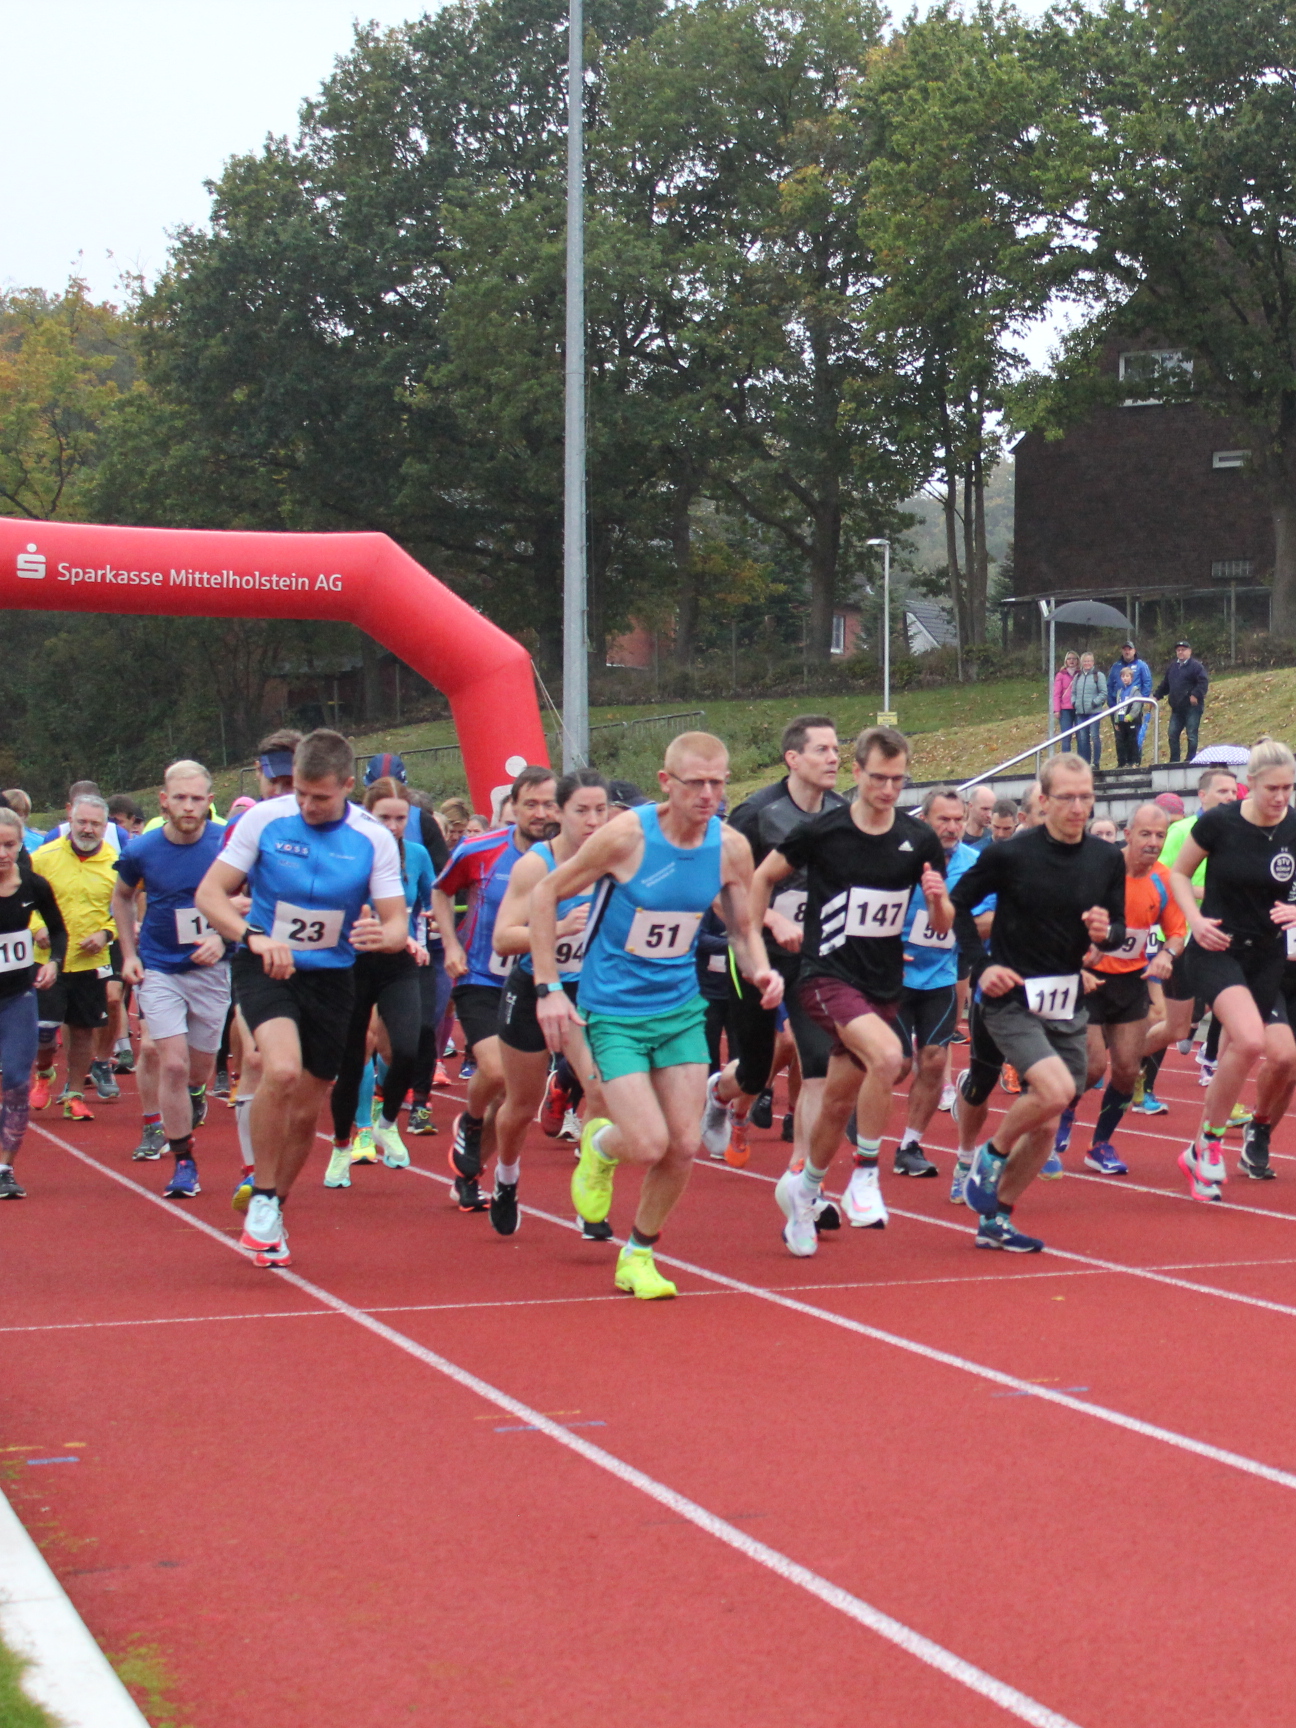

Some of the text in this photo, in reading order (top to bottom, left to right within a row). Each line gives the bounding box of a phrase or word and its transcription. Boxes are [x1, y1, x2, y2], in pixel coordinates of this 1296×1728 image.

[57, 562, 343, 592] Sparkasse Mittelholstein AG
[275, 842, 309, 855] VOSS
[1277, 857, 1291, 866] STV
[857, 902, 903, 927] 147
[288, 918, 326, 943] 23
[645, 924, 681, 949] 51
[555, 942, 584, 965] 94
[1035, 987, 1070, 1013] 111
